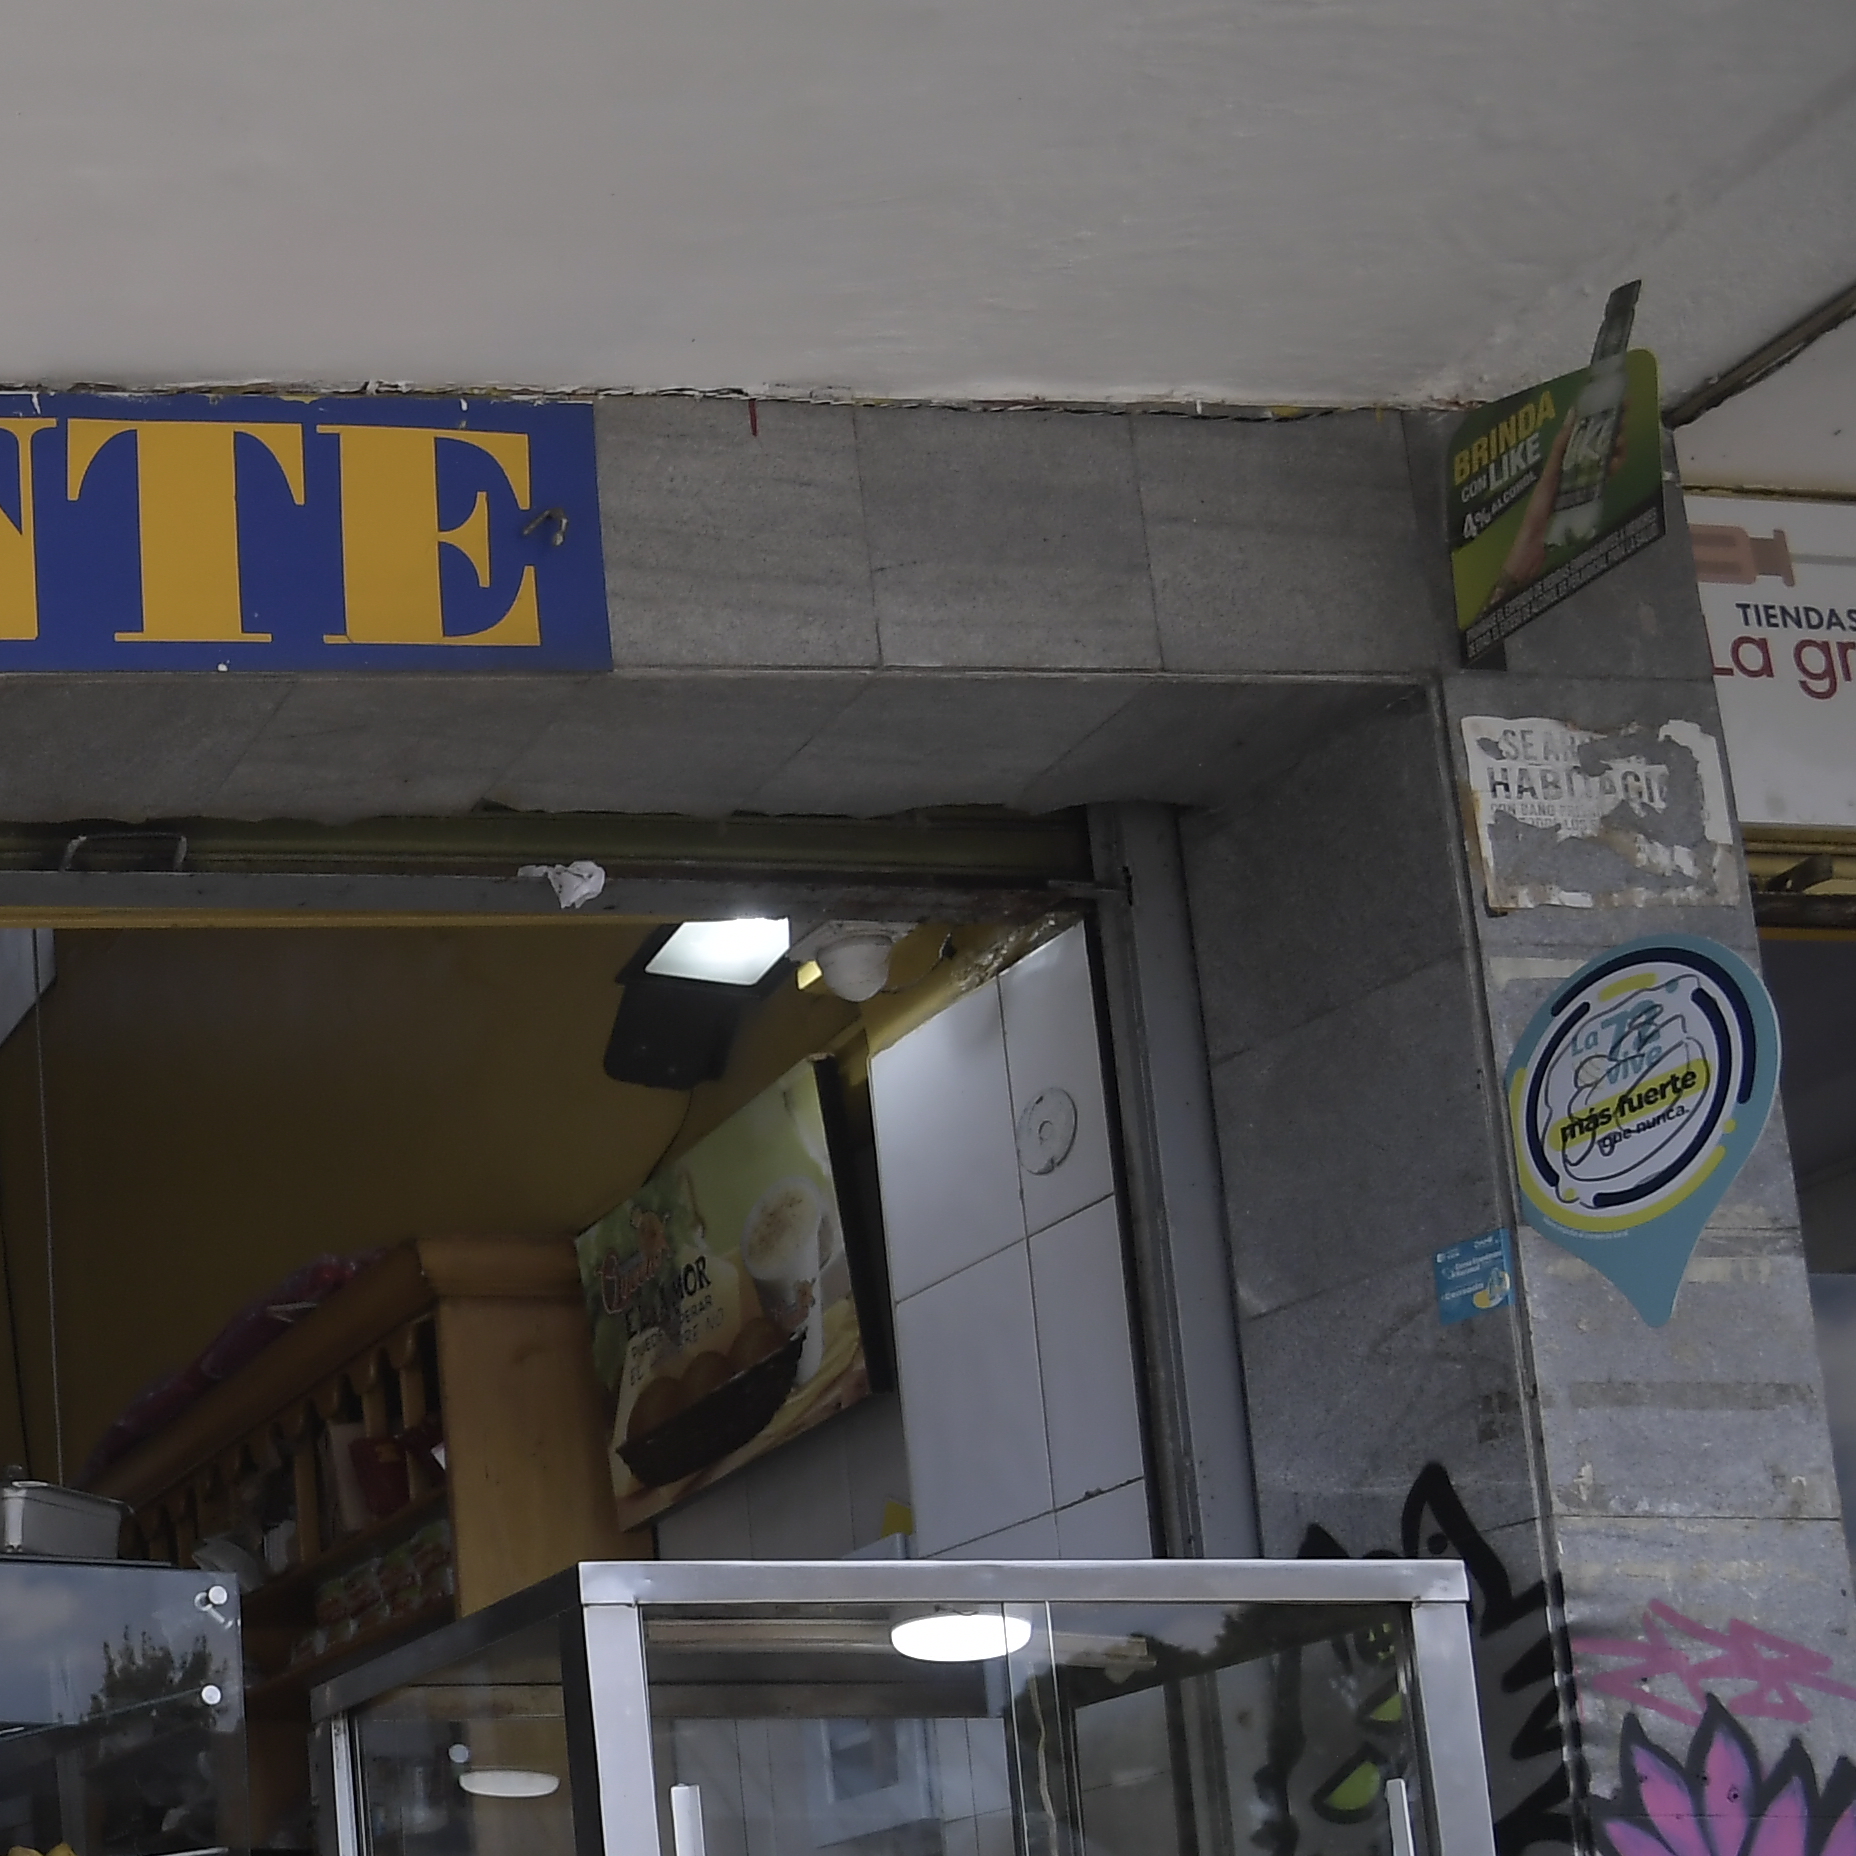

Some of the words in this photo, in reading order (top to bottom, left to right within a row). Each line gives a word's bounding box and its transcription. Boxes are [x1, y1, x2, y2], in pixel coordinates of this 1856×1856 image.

[1454, 390, 1556, 486] BRINDA
[1461, 474, 1488, 504] CON
[1488, 431, 1541, 492] LIKE
[1734, 602, 1856, 632] TIENDAS
[1710, 635, 1775, 678] a
[1499, 729, 1537, 761] SE
[1571, 1030, 1598, 1058] La
[1560, 1106, 1613, 1143] más
[1617, 1070, 1697, 1118] fuerte
